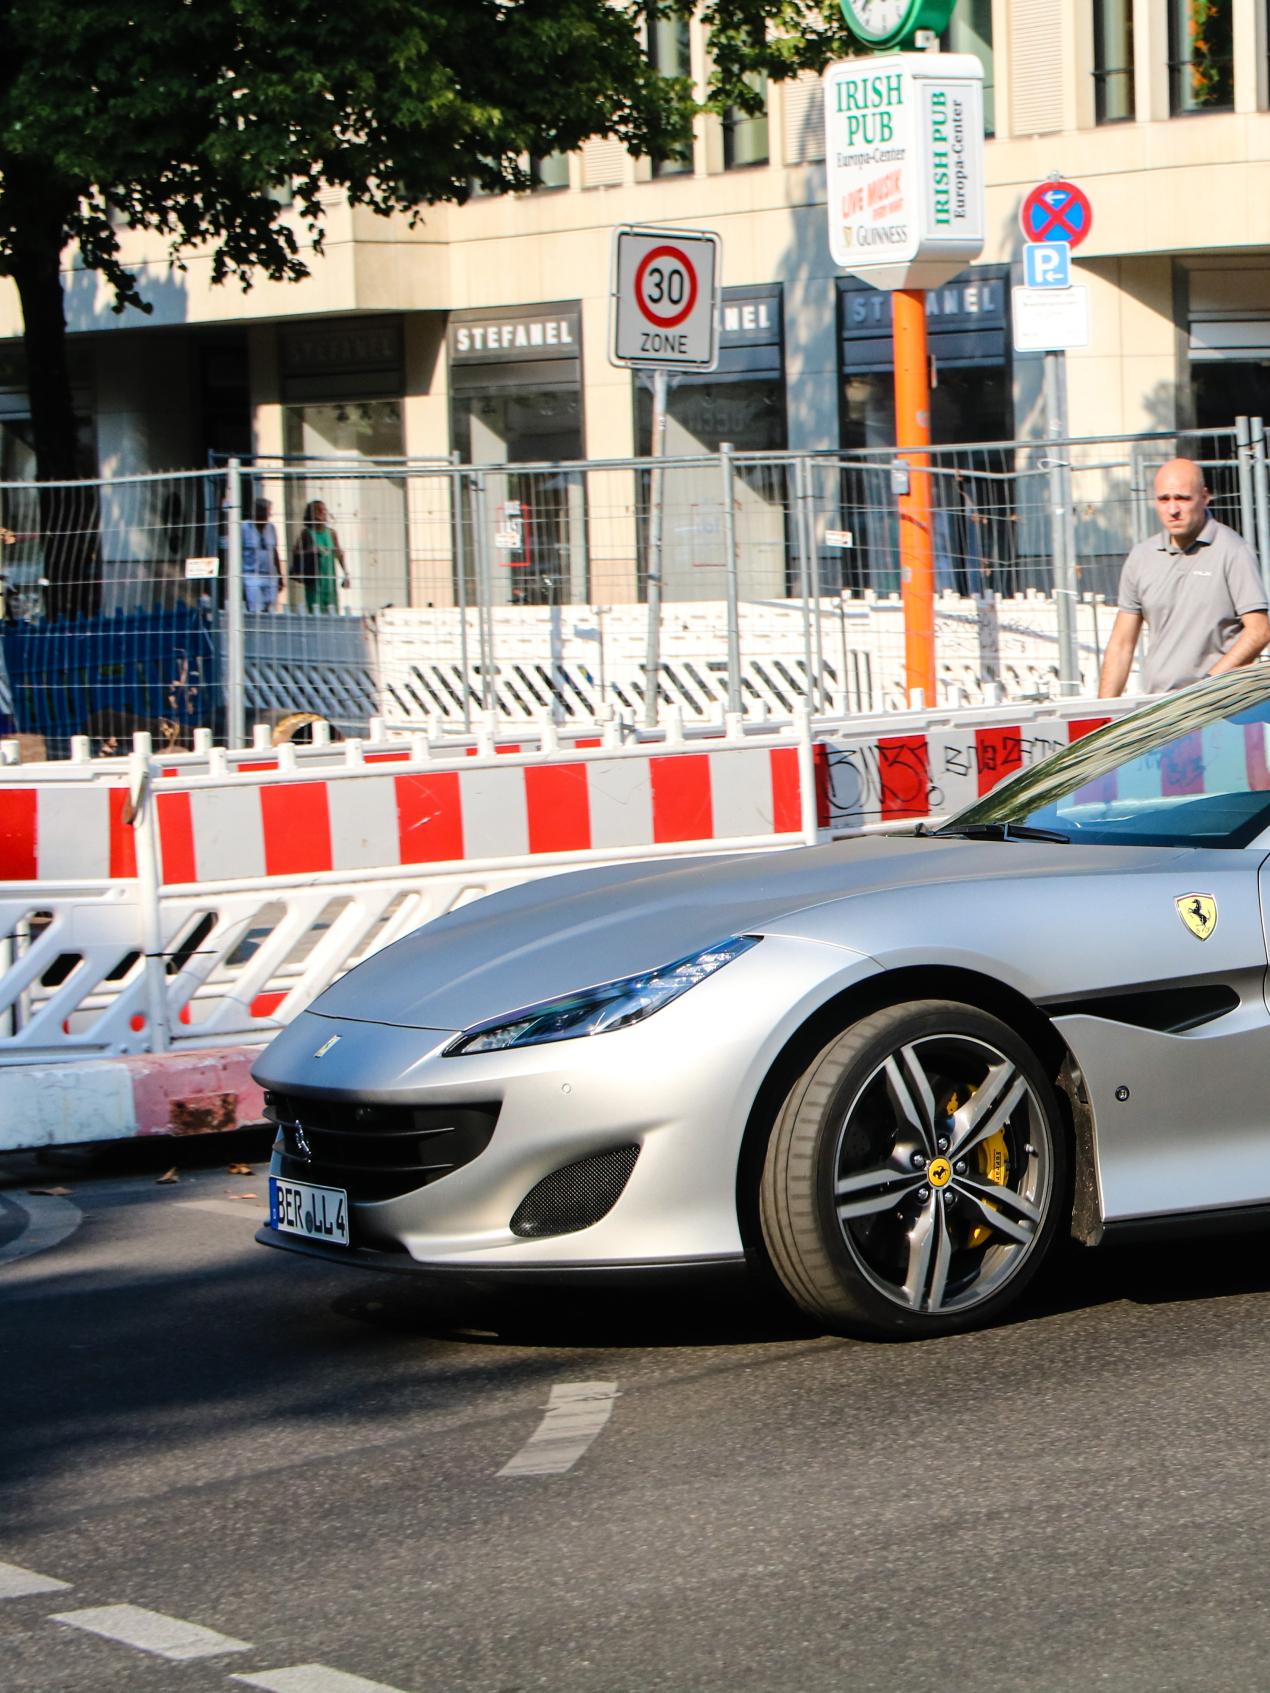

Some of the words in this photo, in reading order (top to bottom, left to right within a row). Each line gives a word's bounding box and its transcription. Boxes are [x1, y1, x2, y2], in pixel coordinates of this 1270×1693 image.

[836, 74, 903, 112] IRISH
[846, 111, 893, 146] PUB
[931, 91, 948, 144] PUB
[836, 147, 906, 170] Europa-Center
[952, 99, 968, 219] Europa-Center
[933, 151, 950, 225] IRISH
[856, 225, 908, 247] GUINNESS
[1034, 248, 1060, 283] P
[647, 267, 684, 306] 30
[456, 321, 573, 351] STEFANEL
[640, 332, 688, 354] ZONE
[276, 1185, 304, 1229] BER
